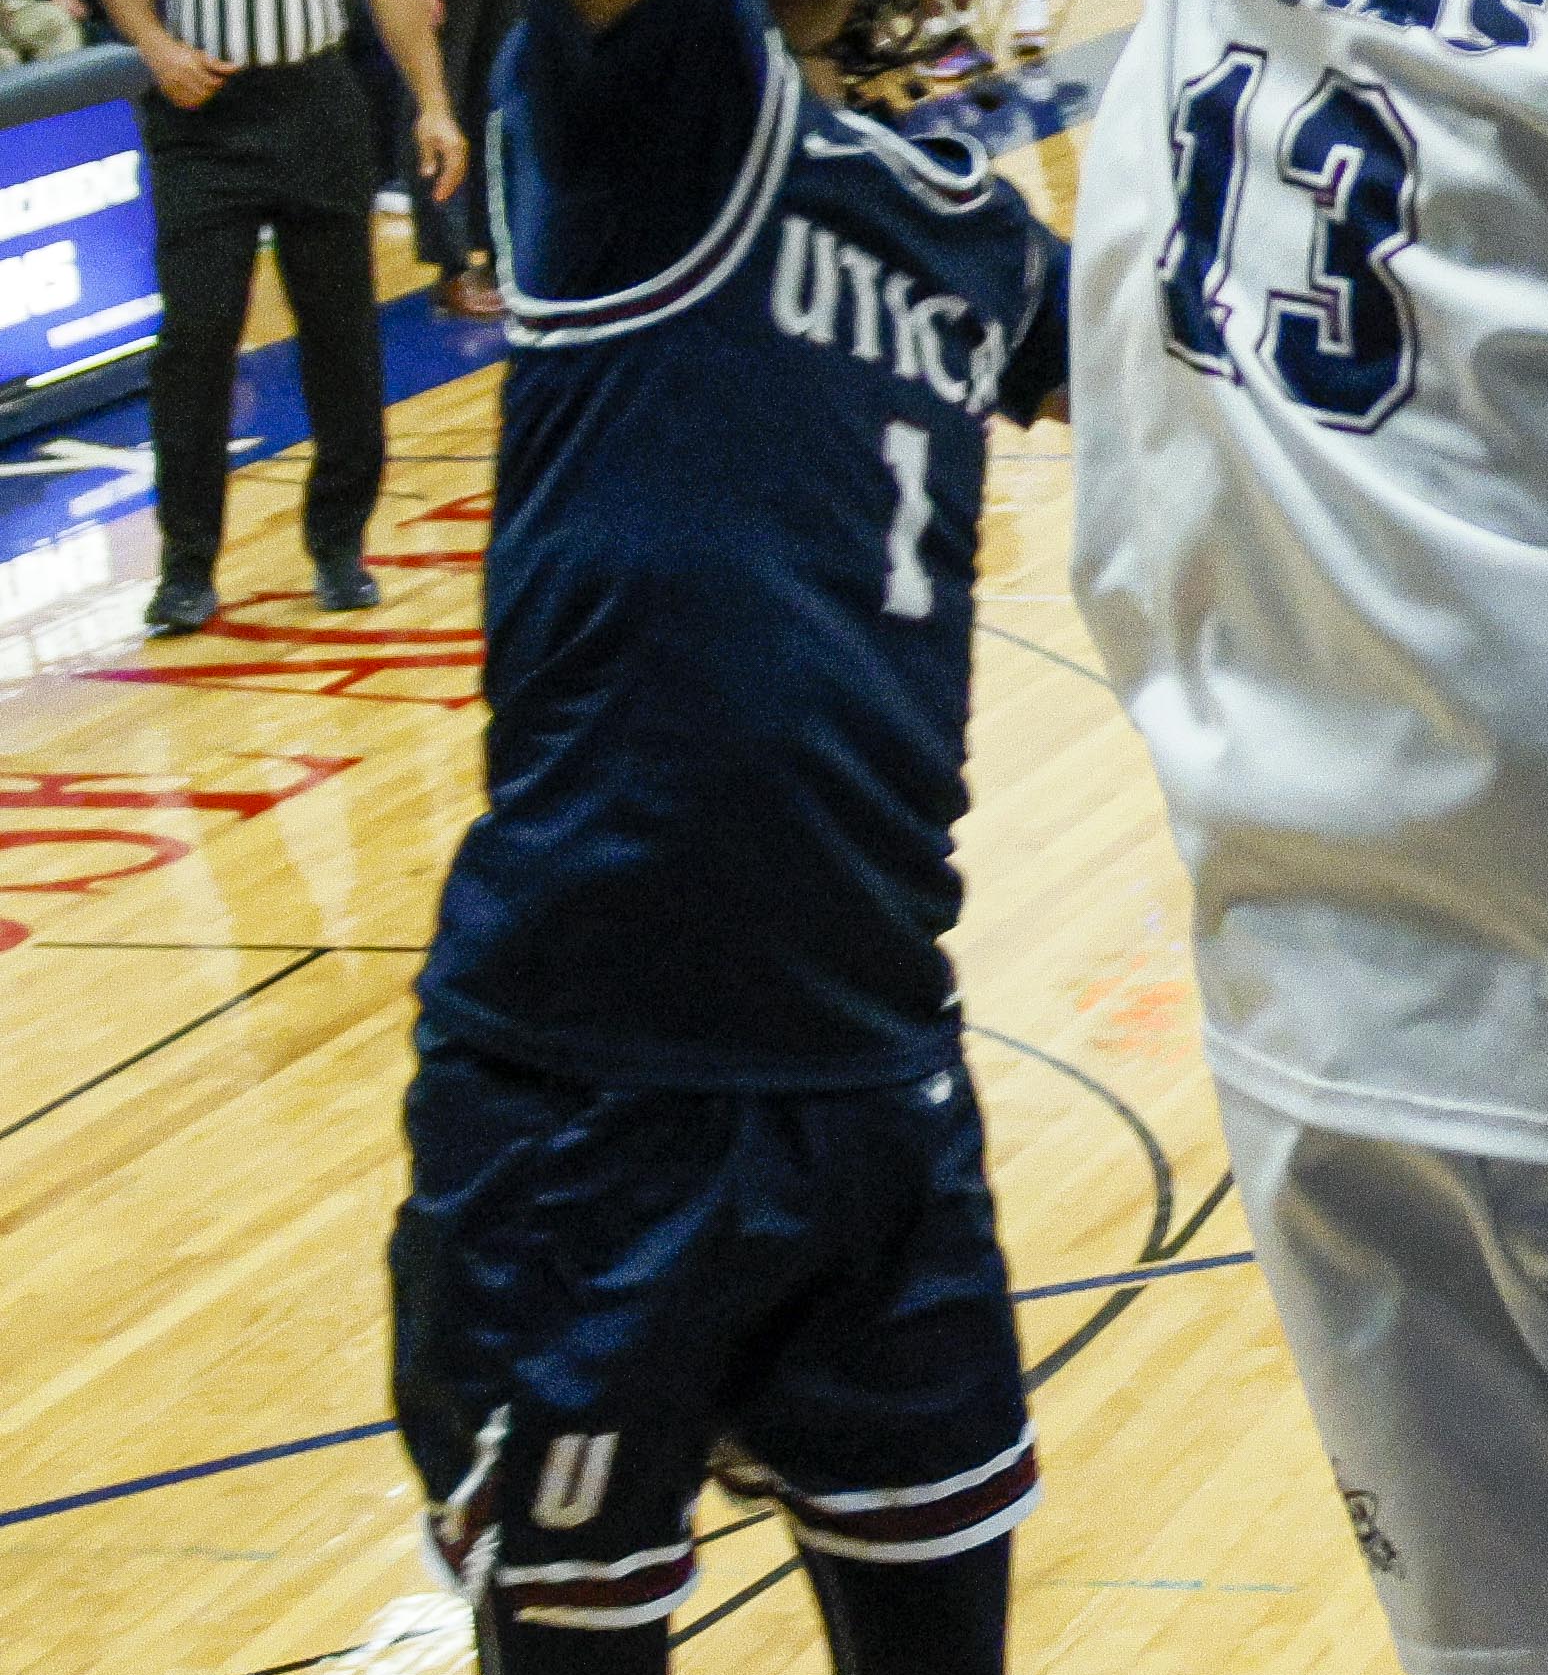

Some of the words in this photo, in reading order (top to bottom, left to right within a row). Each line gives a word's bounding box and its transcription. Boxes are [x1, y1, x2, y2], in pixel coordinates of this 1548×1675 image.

[1154, 42, 1420, 435] 13
[881, 418, 935, 620] 1
[530, 1431, 621, 1530] U
